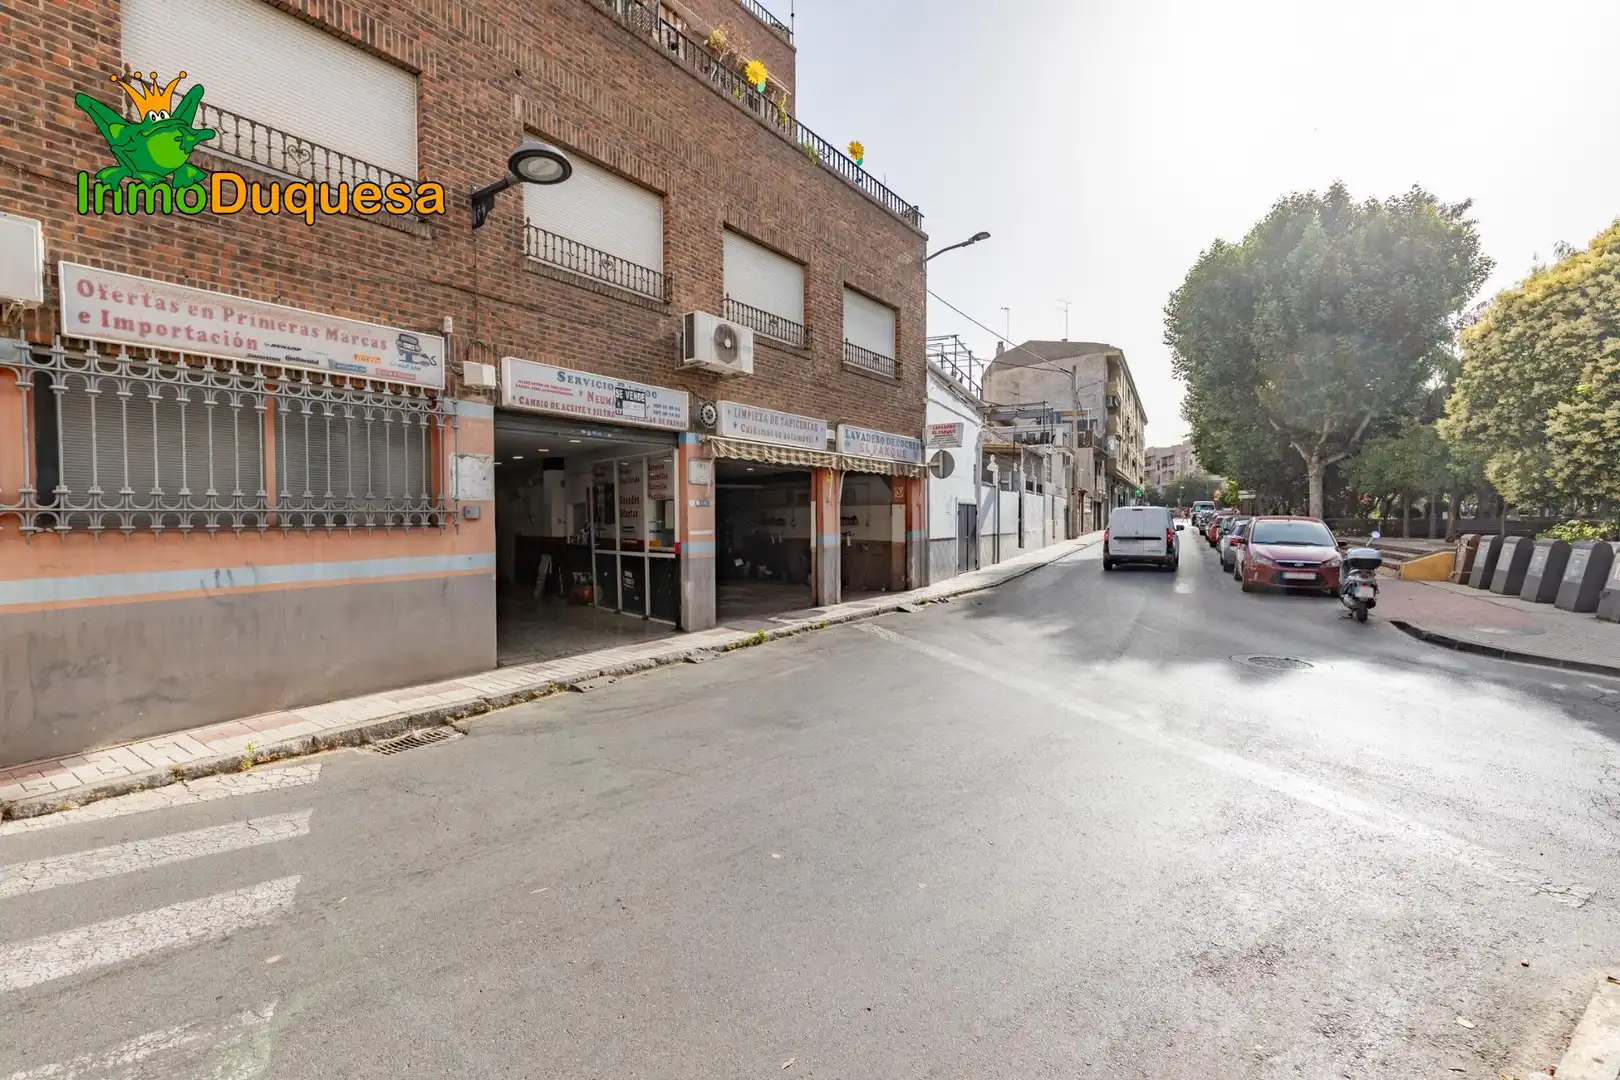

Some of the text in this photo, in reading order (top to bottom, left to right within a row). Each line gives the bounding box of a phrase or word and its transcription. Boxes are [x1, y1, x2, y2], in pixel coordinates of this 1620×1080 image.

[77, 278, 388, 351] Ofertas en Primeras Marcas
[77, 309, 258, 351] e Importación
[556, 371, 614, 391] SERVICIO
[518, 396, 549, 409] CAMBIO
[550, 400, 560, 409] DE
[561, 403, 586, 414] ACEITE
[615, 388, 646, 403] SE VENDE
[733, 407, 768, 424] LIMPIEZA
[769, 416, 779, 426] DE
[844, 428, 885, 444] LAVADERO
[886, 436, 896, 446] DE
